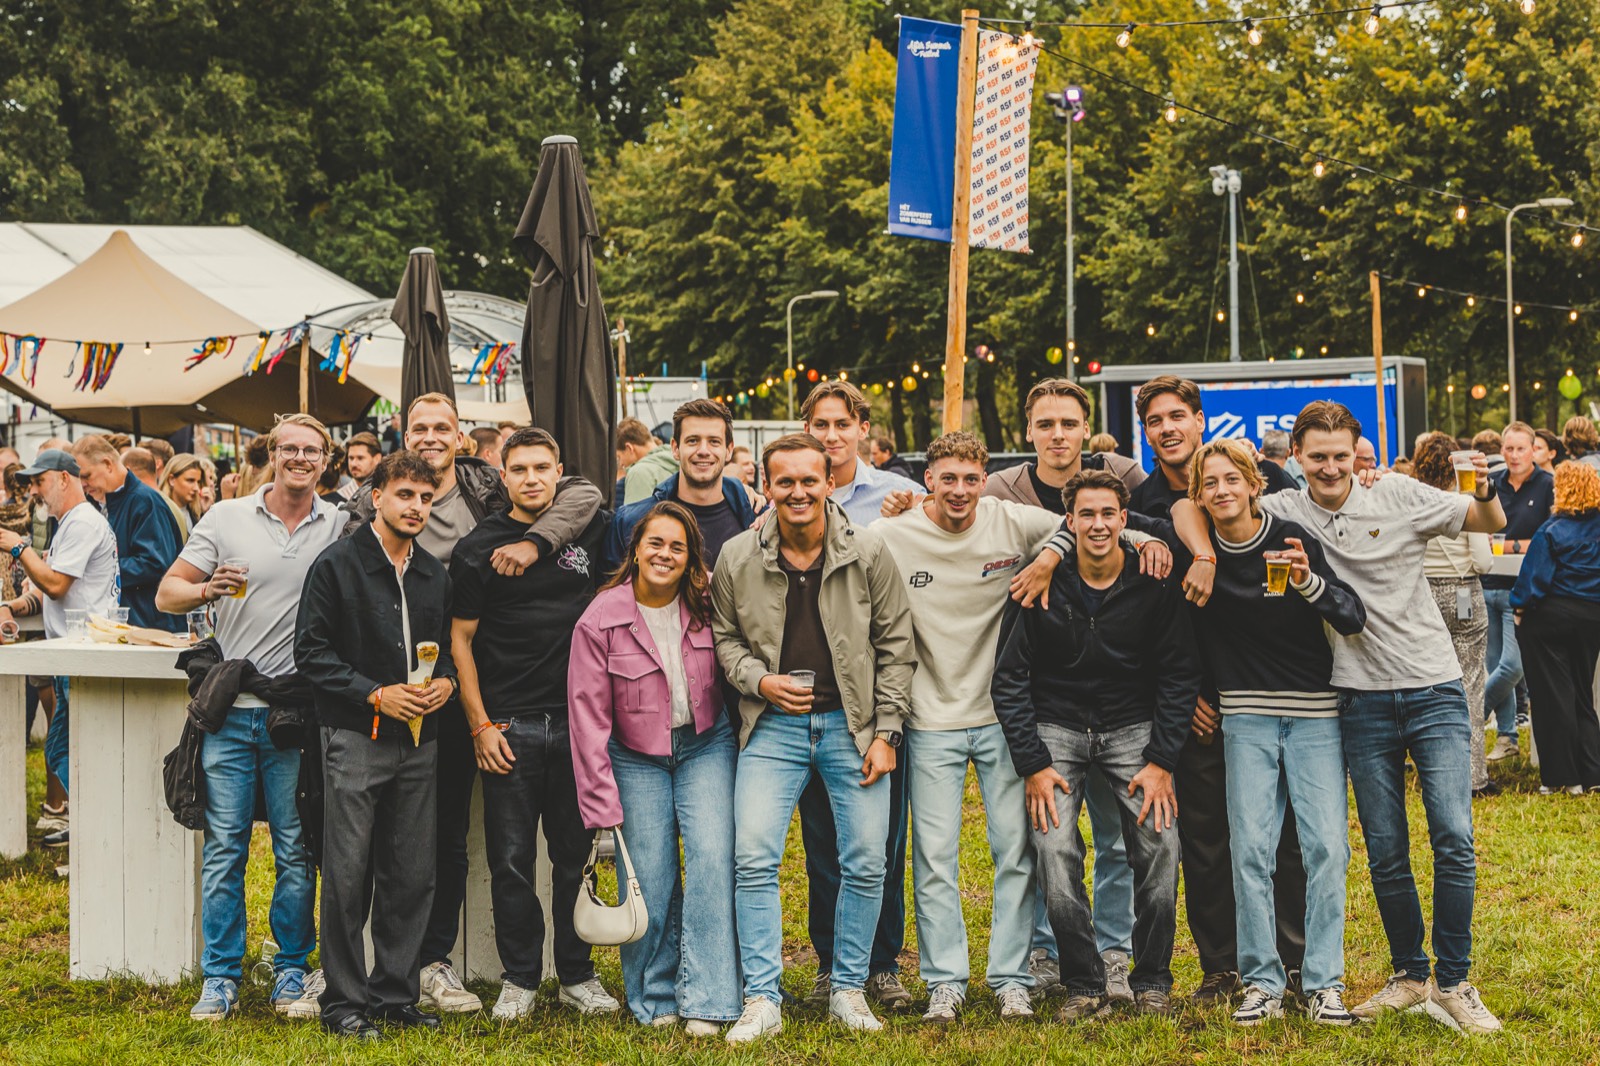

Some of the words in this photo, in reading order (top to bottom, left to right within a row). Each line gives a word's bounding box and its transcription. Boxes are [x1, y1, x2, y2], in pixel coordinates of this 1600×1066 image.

[990, 33, 1003, 42] ASF
[987, 77, 999, 89] ASF
[1002, 70, 1013, 81] ASF
[1016, 62, 1028, 73] ASF
[988, 62, 999, 73] ASF
[1017, 47, 1030, 58] ASF
[986, 108, 998, 120] ASF
[1000, 100, 1012, 111] ASF
[1014, 92, 1025, 104] ASF
[987, 93, 998, 104] ASF
[1000, 84, 1012, 96] ASF
[1015, 76, 1026, 88] ASF
[972, 132, 983, 144] ASF
[986, 123, 997, 135] ASF
[1000, 115, 1011, 127] ASF
[1014, 107, 1025, 118] ASF
[972, 147, 983, 159] ASF
[986, 139, 997, 151] ASF
[1000, 130, 1011, 143] ASF
[1014, 122, 1025, 133] ASF
[972, 162, 983, 174] ASF
[986, 154, 997, 166] ASF
[1000, 146, 1012, 158] ASF
[1014, 137, 1025, 149] ASF
[972, 178, 983, 190] ASF
[986, 169, 997, 181] ASF
[1000, 161, 1012, 173] ASF
[1014, 153, 1025, 165] ASF
[973, 193, 984, 205] ASF
[986, 185, 998, 197] ASF
[1000, 176, 1012, 188] ASF
[1015, 168, 1026, 180] ASF
[973, 208, 984, 221] ASF
[987, 200, 999, 212] ASF
[1001, 192, 1013, 203] ASF
[1015, 182, 1027, 195] ASF
[973, 224, 986, 236] ASF
[988, 215, 1000, 227] ASF
[1002, 206, 1013, 219] ASF
[1016, 197, 1029, 211] ASF
[989, 230, 1000, 242] ASF
[1003, 222, 1015, 233] ASF
[1005, 236, 1016, 249] ASF
